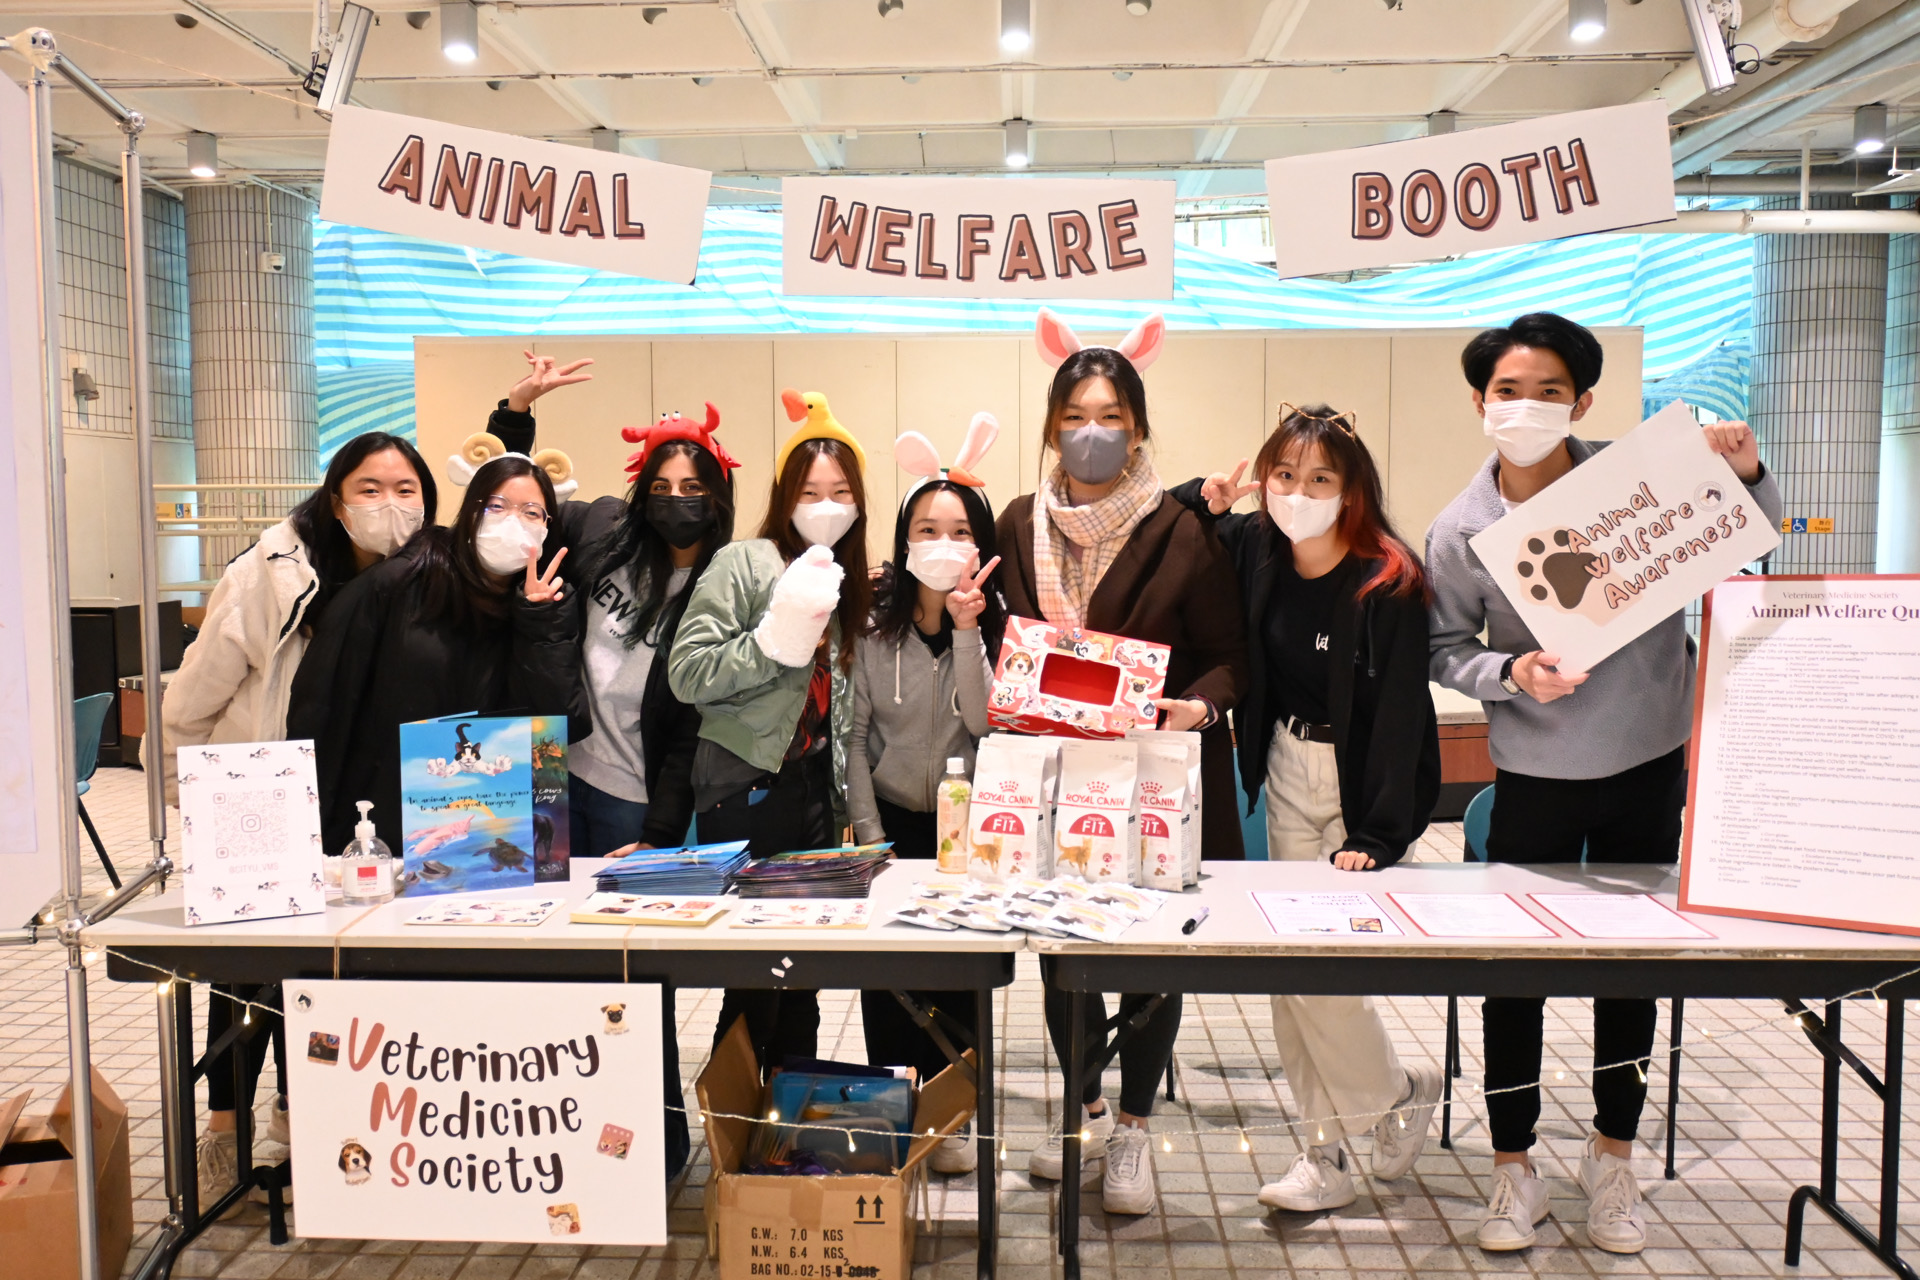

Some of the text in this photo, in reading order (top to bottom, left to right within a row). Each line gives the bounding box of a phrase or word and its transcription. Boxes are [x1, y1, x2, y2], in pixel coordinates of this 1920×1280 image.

[378, 134, 645, 240] ANIMAL
[1352, 137, 1599, 241] BOOTH
[810, 194, 1146, 282] WELFARE
[1567, 481, 1659, 555] Animal
[1603, 504, 1747, 609] Awareness
[590, 578, 639, 622] NEW
[1782, 591, 1825, 600] Veterinary
[1869, 591, 1899, 600] Society
[1747, 604, 1810, 618] Animal
[1816, 604, 1887, 618] Welfare
[978, 791, 1034, 805] ROYAL CANIN
[1065, 793, 1125, 806] ROYAL CANIN
[1149, 796, 1176, 807] CANIN
[992, 818, 1016, 832] FIT
[1081, 820, 1106, 834] FIT
[348, 1017, 600, 1082] Veterinary
[369, 1082, 582, 1140] Medicine
[389, 1142, 564, 1194] Society
[790, 1228, 808, 1241] 7.0
[823, 1229, 844, 1241] KGS
[789, 1246, 808, 1259] 6.4
[823, 1247, 844, 1259] KGS
[751, 1264, 771, 1276] BAG
